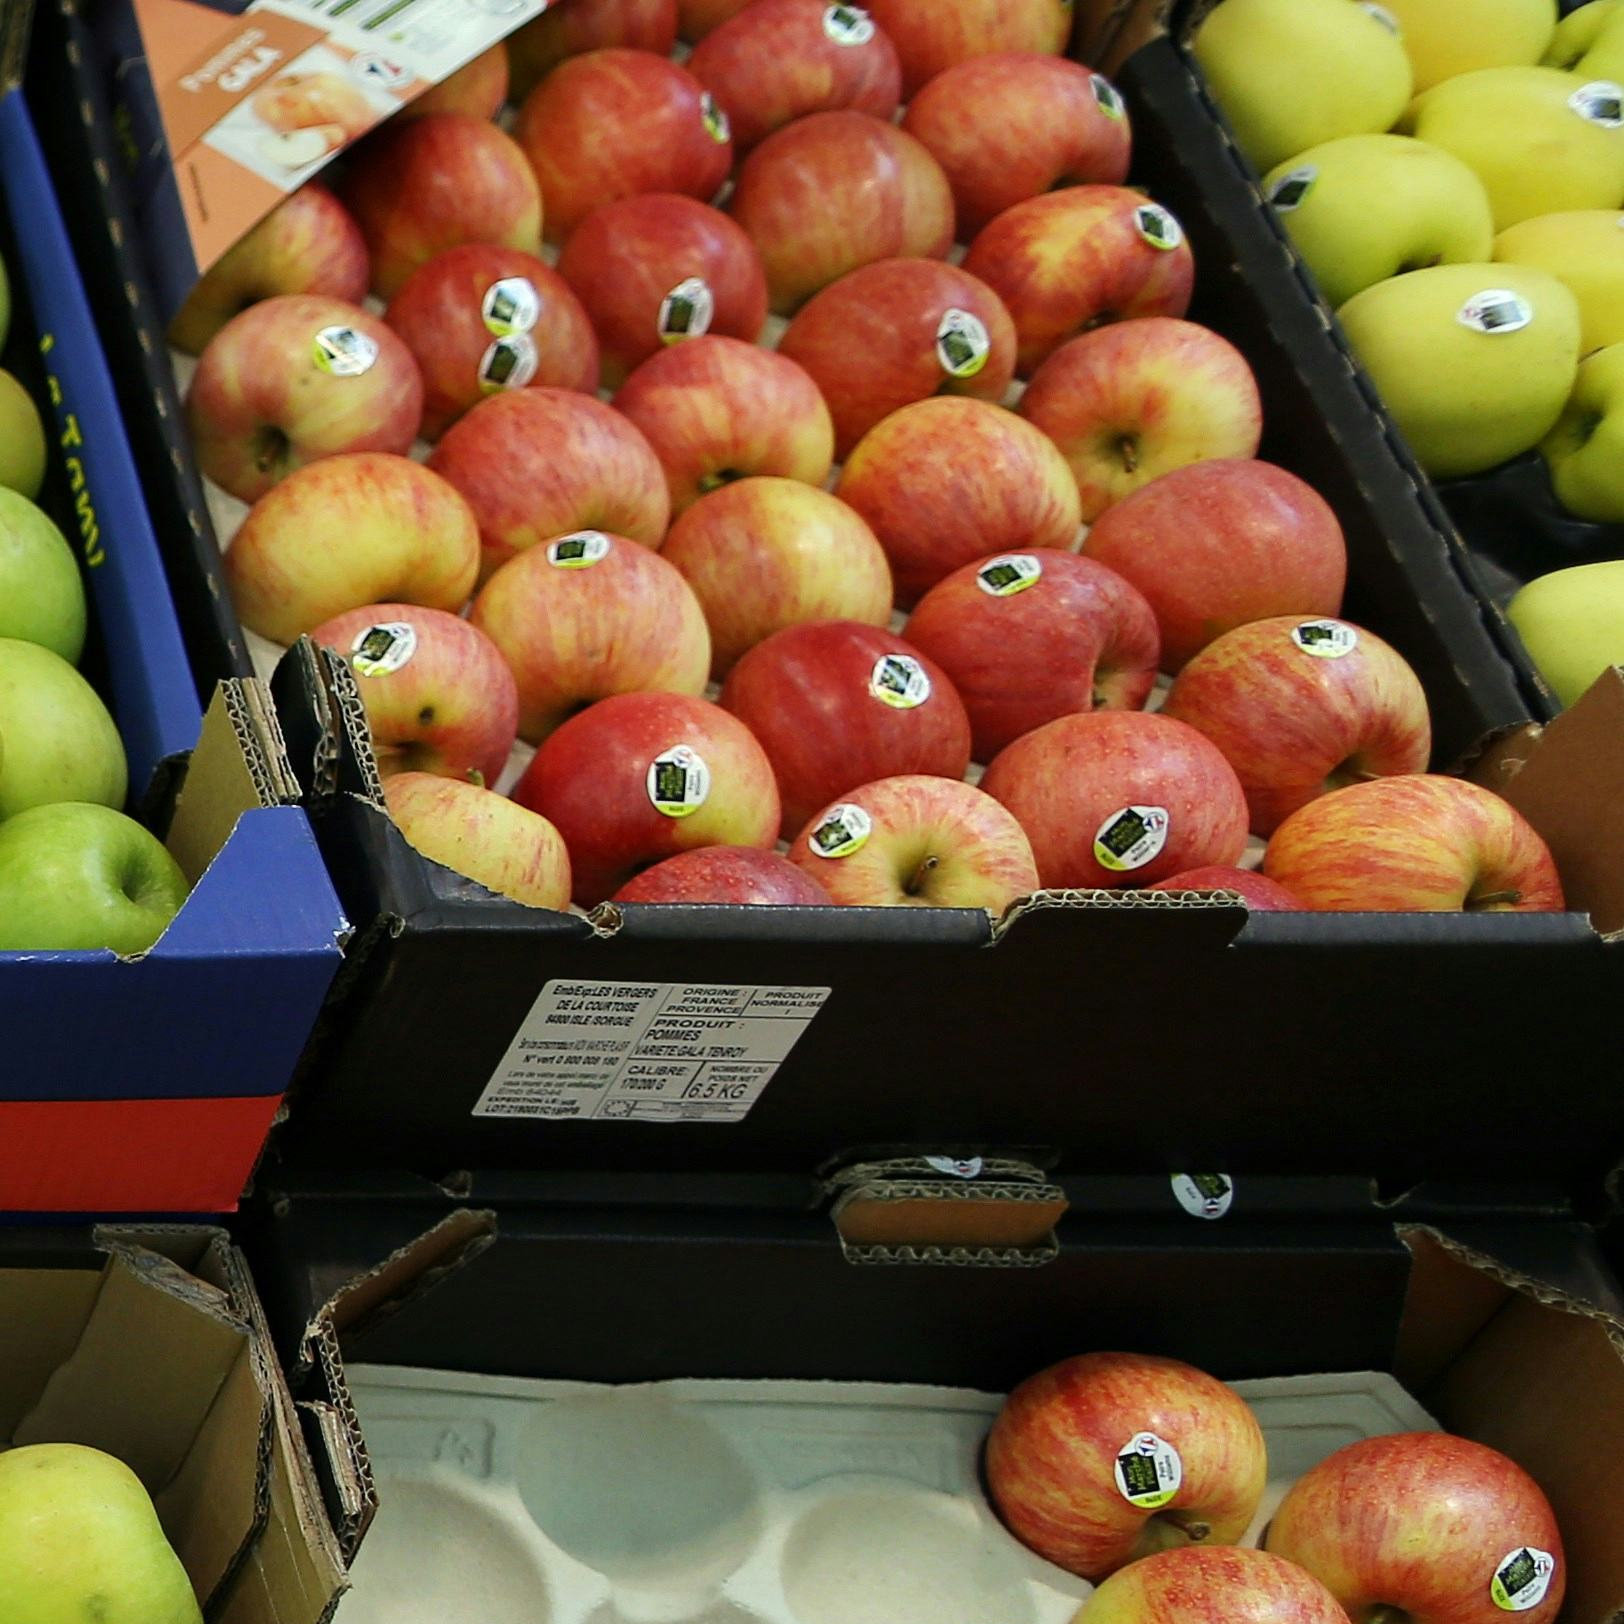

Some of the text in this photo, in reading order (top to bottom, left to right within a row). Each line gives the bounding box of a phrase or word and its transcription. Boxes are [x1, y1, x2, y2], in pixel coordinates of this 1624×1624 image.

[612, 986, 658, 999] VERGERS
[682, 987, 740, 996] ORIGINE
[765, 991, 823, 1000] PRODUIT
[556, 1000, 571, 1010] DE
[572, 1000, 584, 1010] LA
[682, 997, 738, 1006] FRANCE
[667, 1005, 742, 1014] PROVENCE
[654, 1018, 736, 1029] PRODUIT
[644, 1029, 702, 1041] POMMES
[717, 1084, 747, 1099] KG
